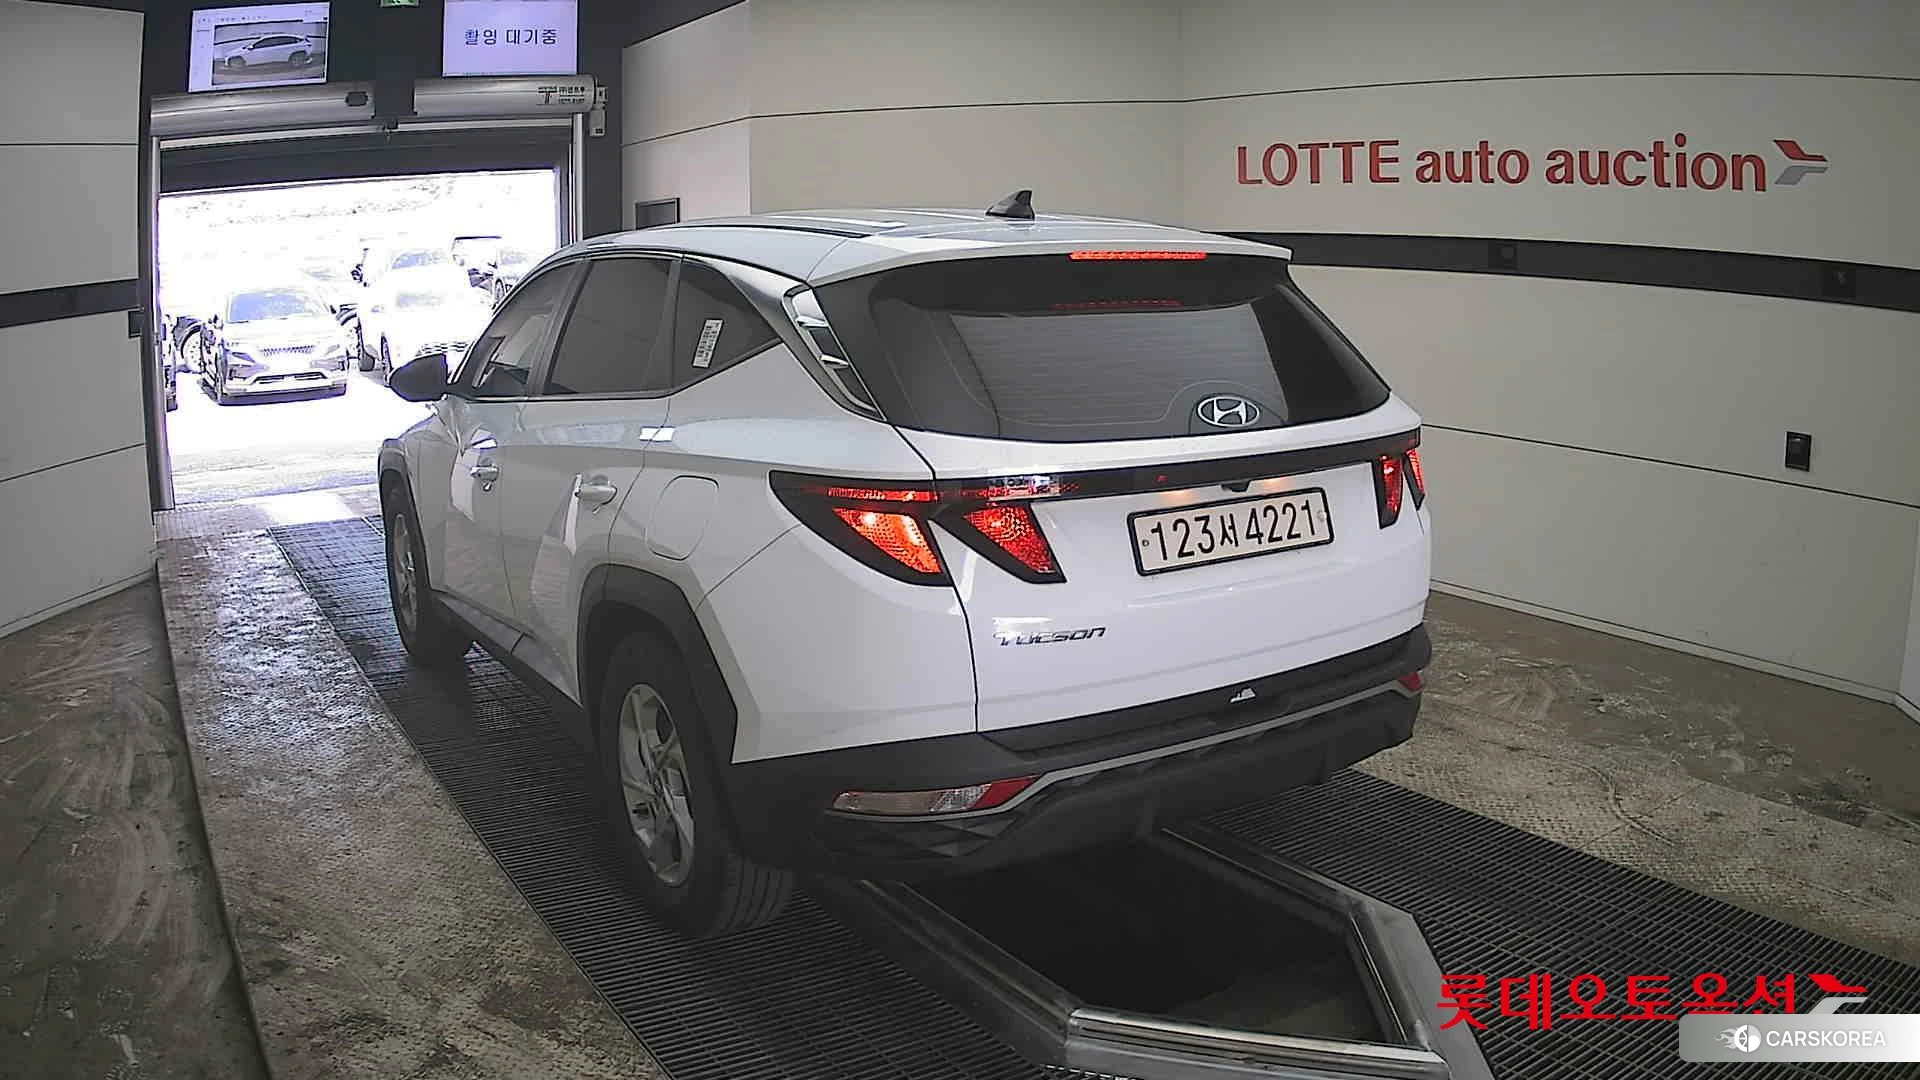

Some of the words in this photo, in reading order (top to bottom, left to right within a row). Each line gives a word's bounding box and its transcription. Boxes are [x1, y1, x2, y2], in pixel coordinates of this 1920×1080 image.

[506, 28, 557, 45] 대기중
[1237, 140, 1399, 186] LOTTE
[1415, 140, 1529, 184] auto
[1545, 132, 1767, 192] auction
